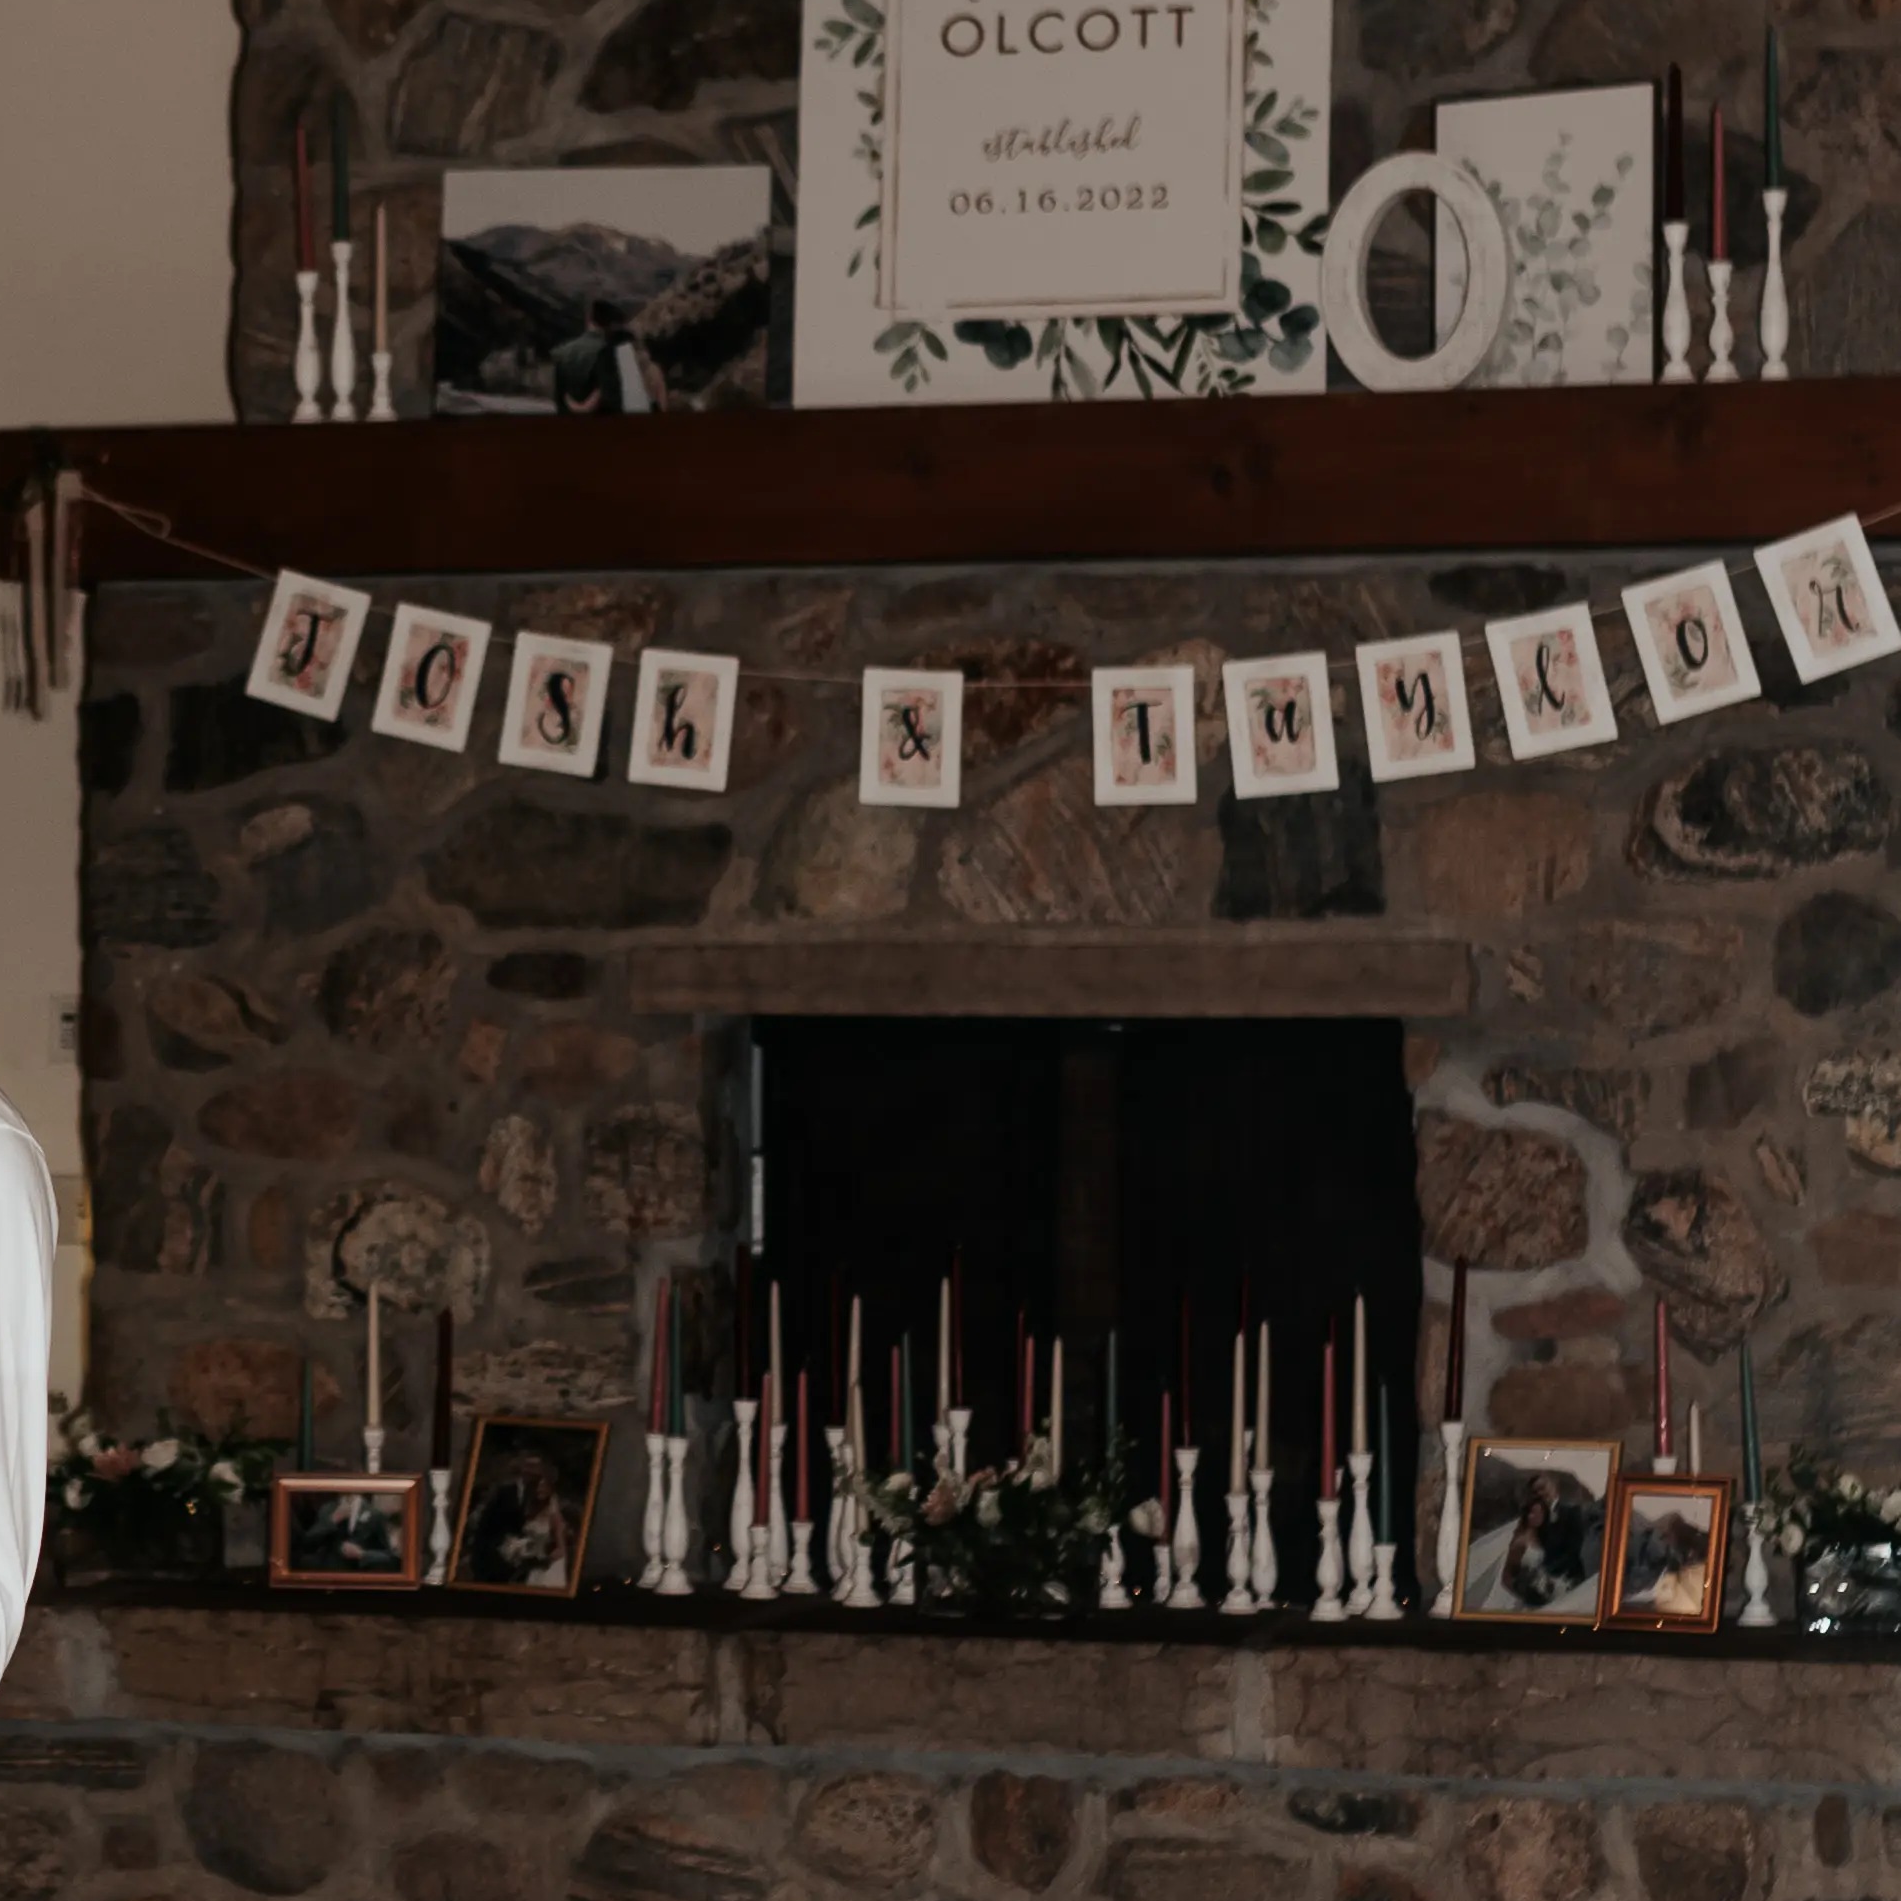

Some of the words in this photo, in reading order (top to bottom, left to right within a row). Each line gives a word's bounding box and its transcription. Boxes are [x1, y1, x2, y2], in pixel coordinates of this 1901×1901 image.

[940, 4, 1195, 58] OLCOTT
[982, 110, 1141, 163] established
[949, 183, 1170, 216] 06.16.2022
[897, 706, 931, 762] &
